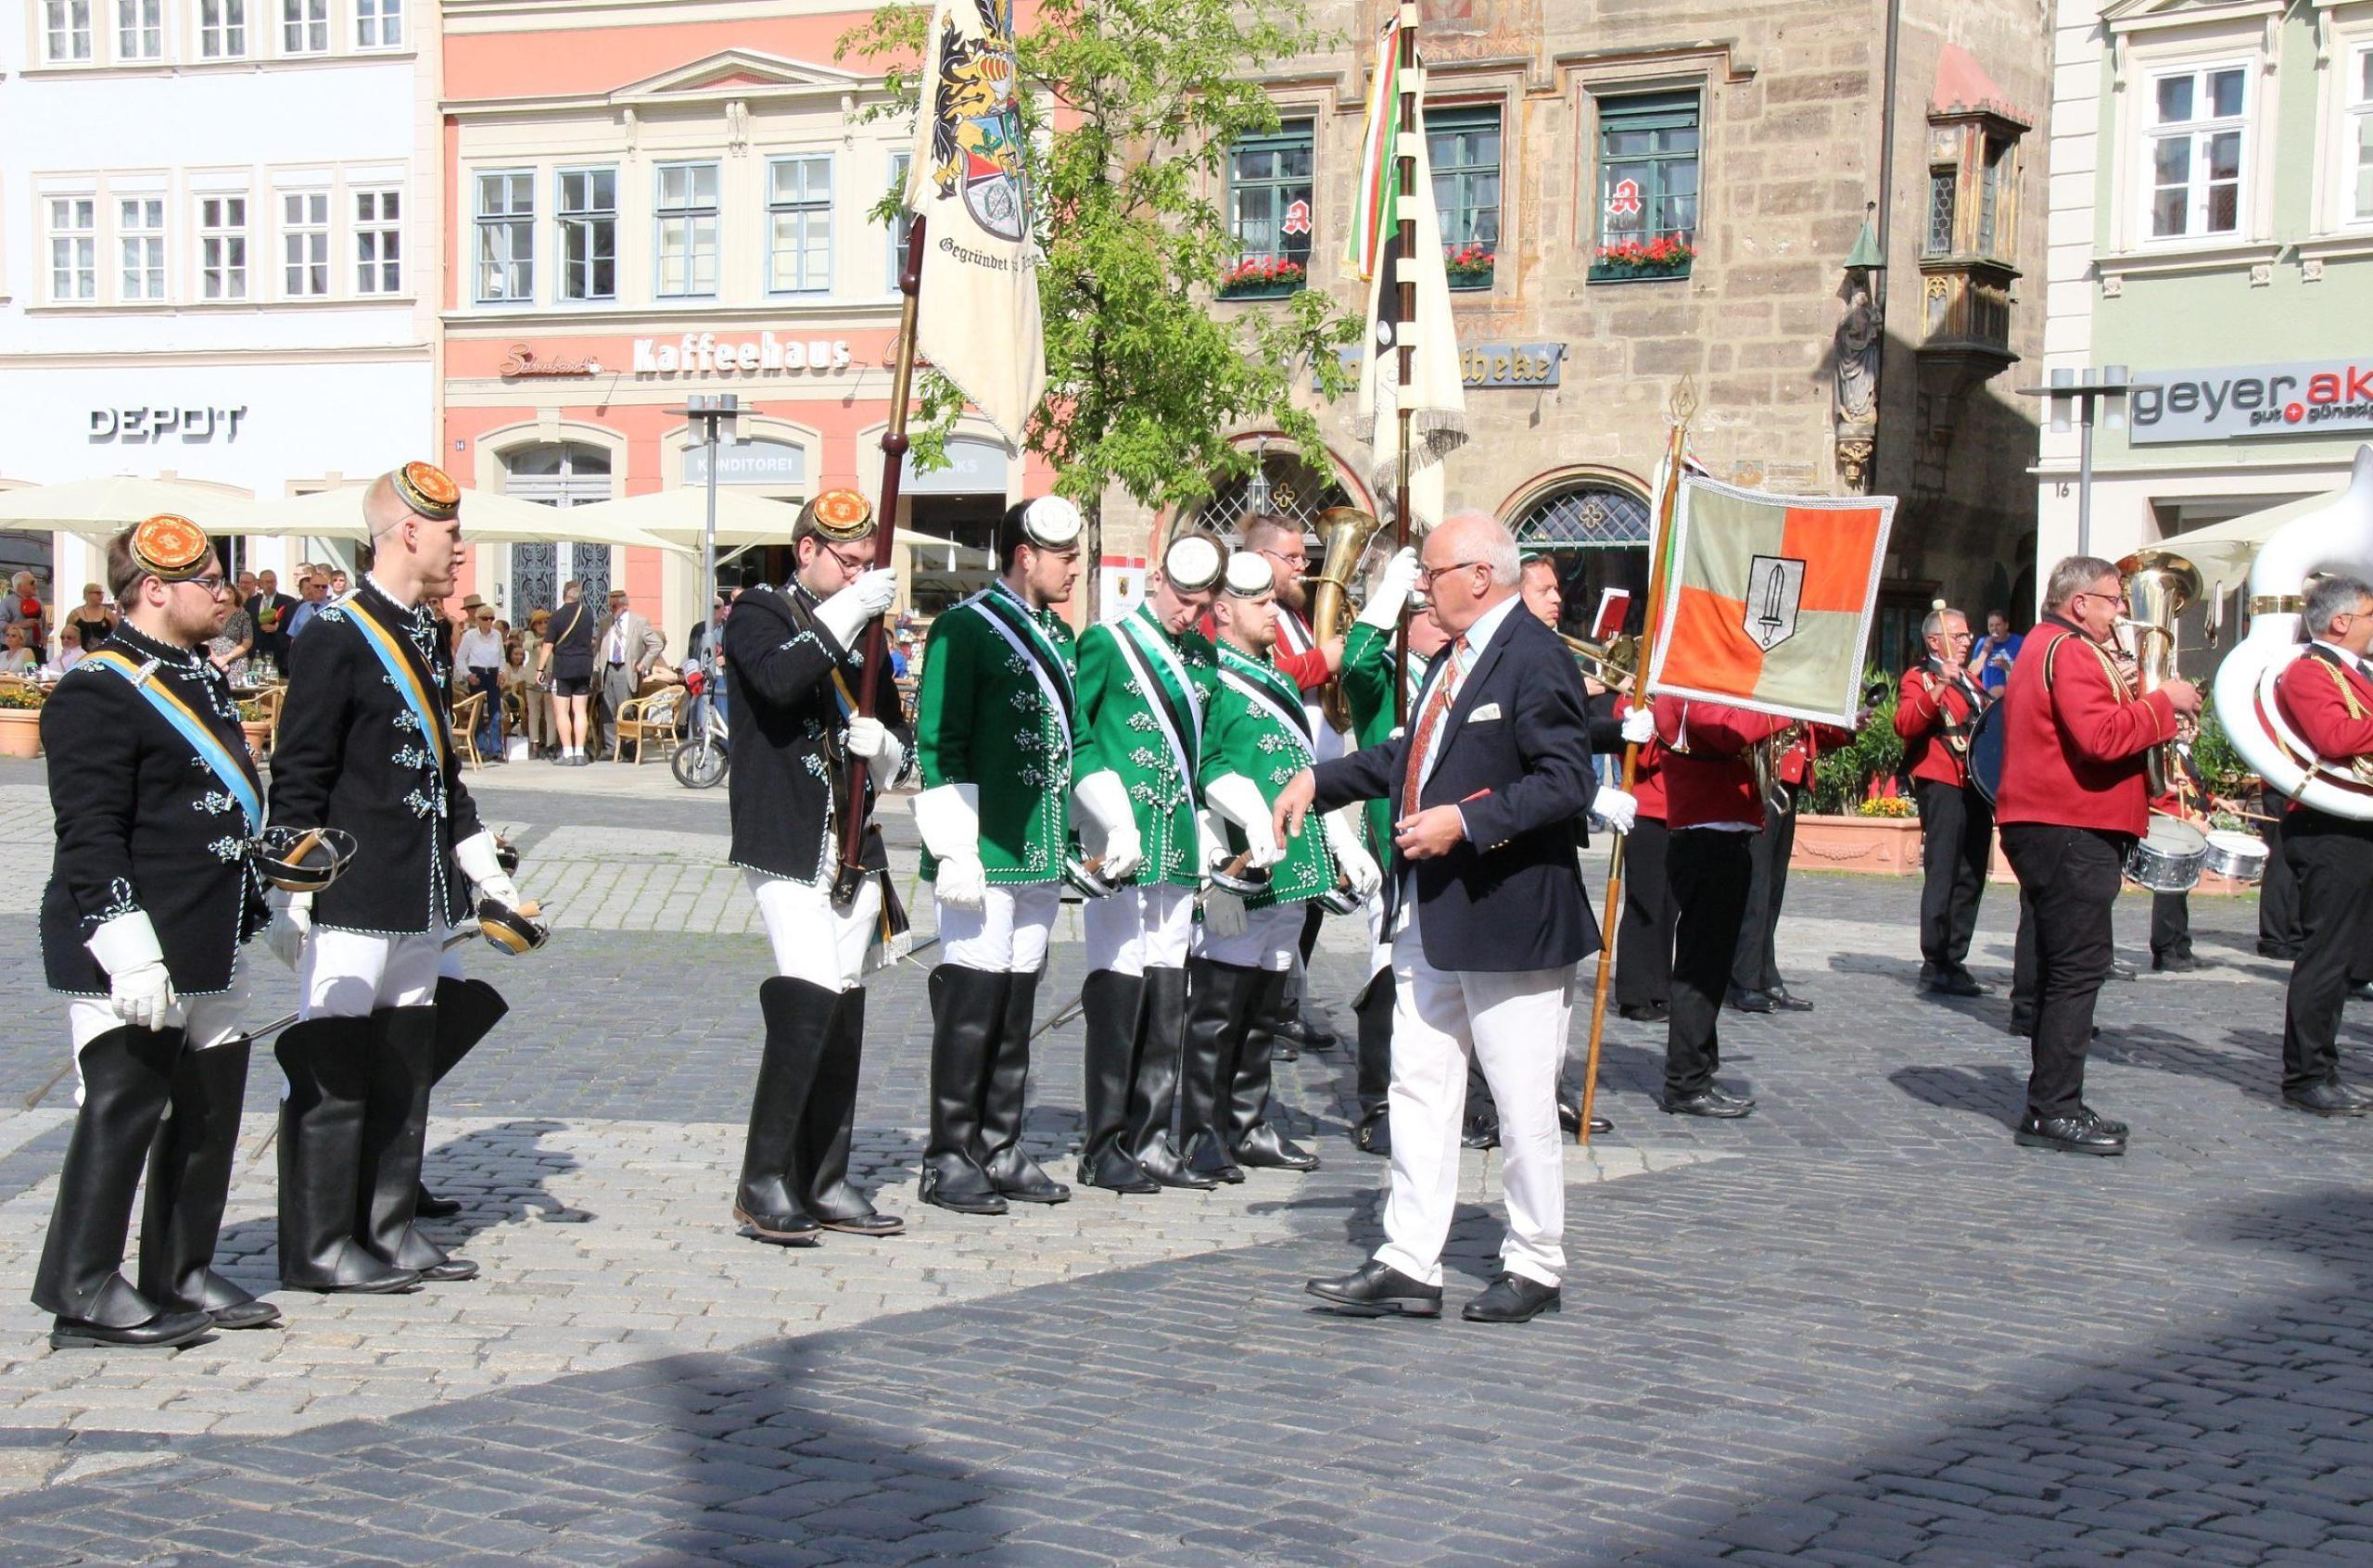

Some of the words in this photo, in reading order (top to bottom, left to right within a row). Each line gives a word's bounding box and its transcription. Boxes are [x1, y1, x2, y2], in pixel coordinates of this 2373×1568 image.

[939, 237, 1009, 271] Gegründet
[633, 331, 853, 374] Kaffeehaus
[2133, 375, 2297, 425] geyer
[2250, 408, 2282, 426] gut
[87, 406, 247, 444] DEPOT
[696, 458, 793, 473] KNDITOREI
[2055, 481, 2070, 499] 16
